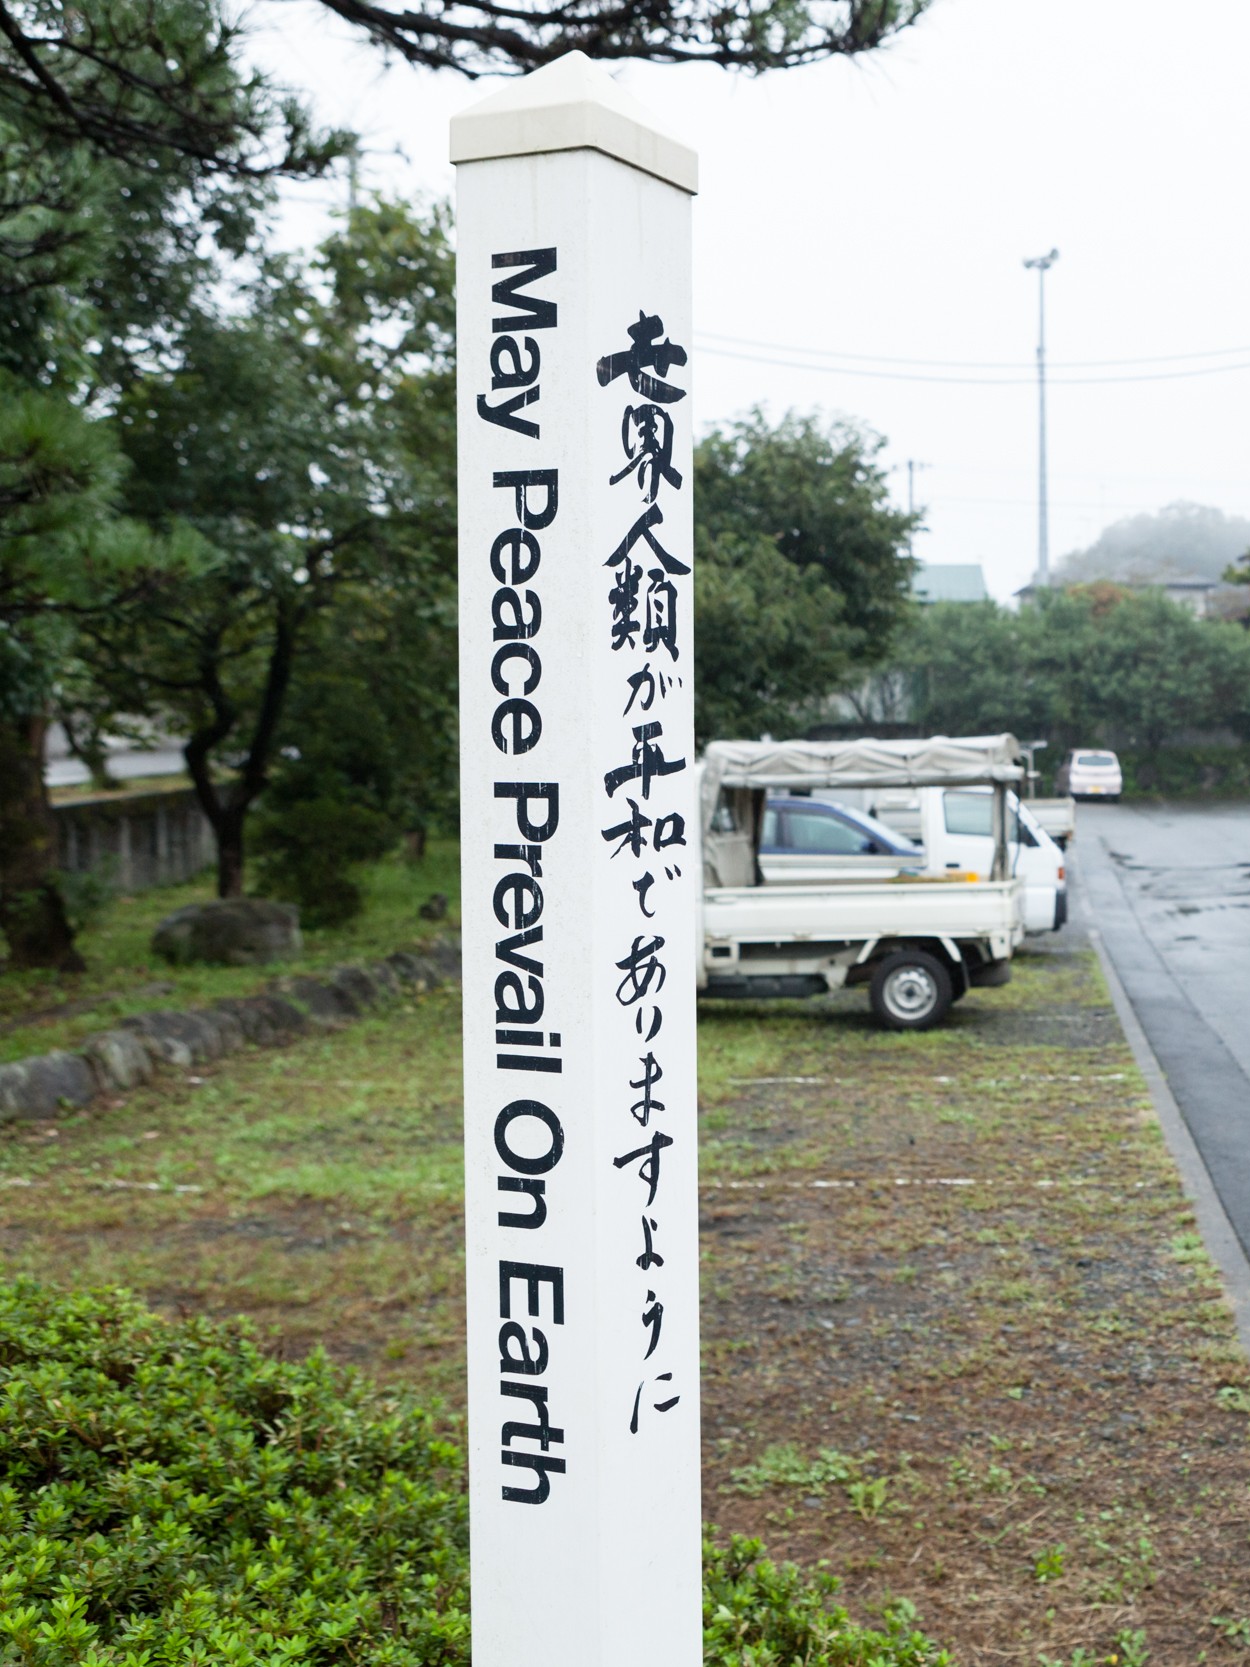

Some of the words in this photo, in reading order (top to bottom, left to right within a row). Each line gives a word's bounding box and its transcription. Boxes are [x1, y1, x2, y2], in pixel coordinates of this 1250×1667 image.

[477, 247, 558, 440] May
[490, 469, 559, 755] Peace
[492, 782, 563, 1074] Prevail
[596, 309, 692, 1436] 世界人類が平和でありますように
[494, 1099, 565, 1230] On
[498, 1259, 566, 1505] Earth
